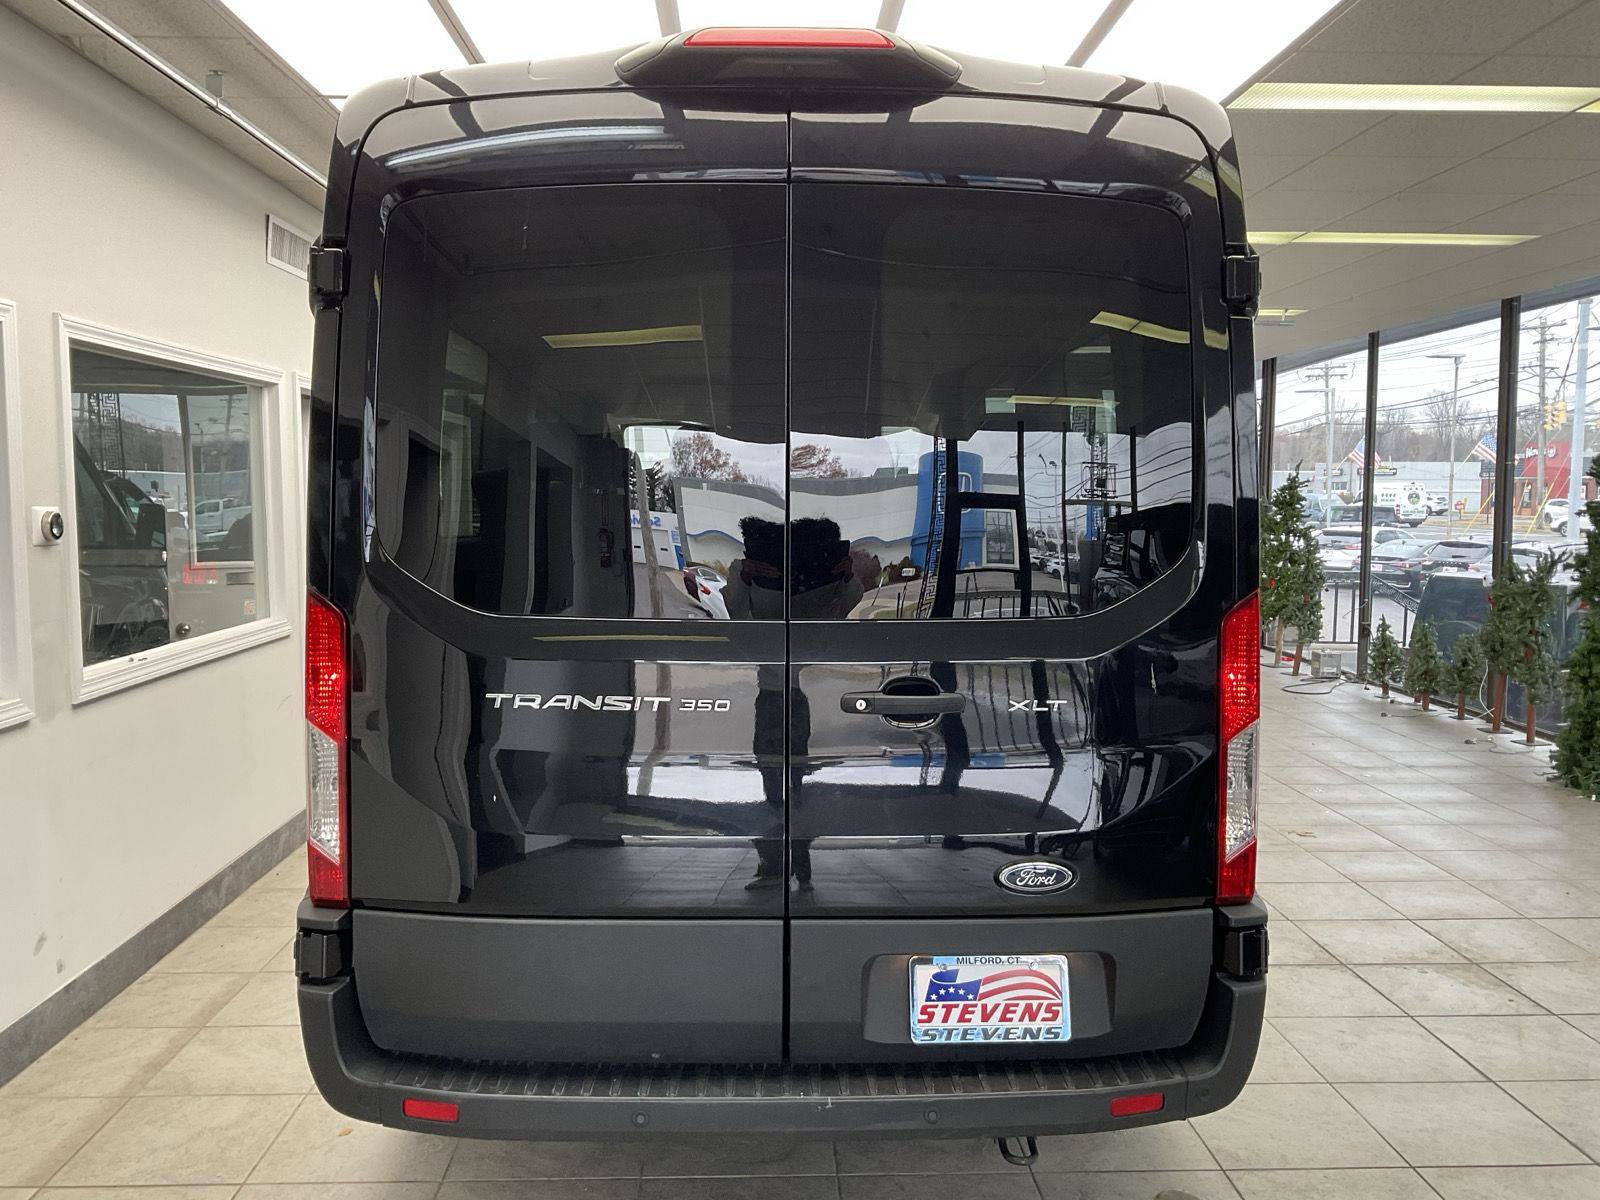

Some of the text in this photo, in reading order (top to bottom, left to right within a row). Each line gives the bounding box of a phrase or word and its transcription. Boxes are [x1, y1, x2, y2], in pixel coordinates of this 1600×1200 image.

[485, 693, 731, 712] TRANSIT 350
[1008, 699, 1068, 712] XLT
[1016, 868, 1057, 886] Ford
[1008, 956, 1021, 965] CT
[917, 1002, 1063, 1024] STEVENS
[920, 1027, 1063, 1042] STEVENS
